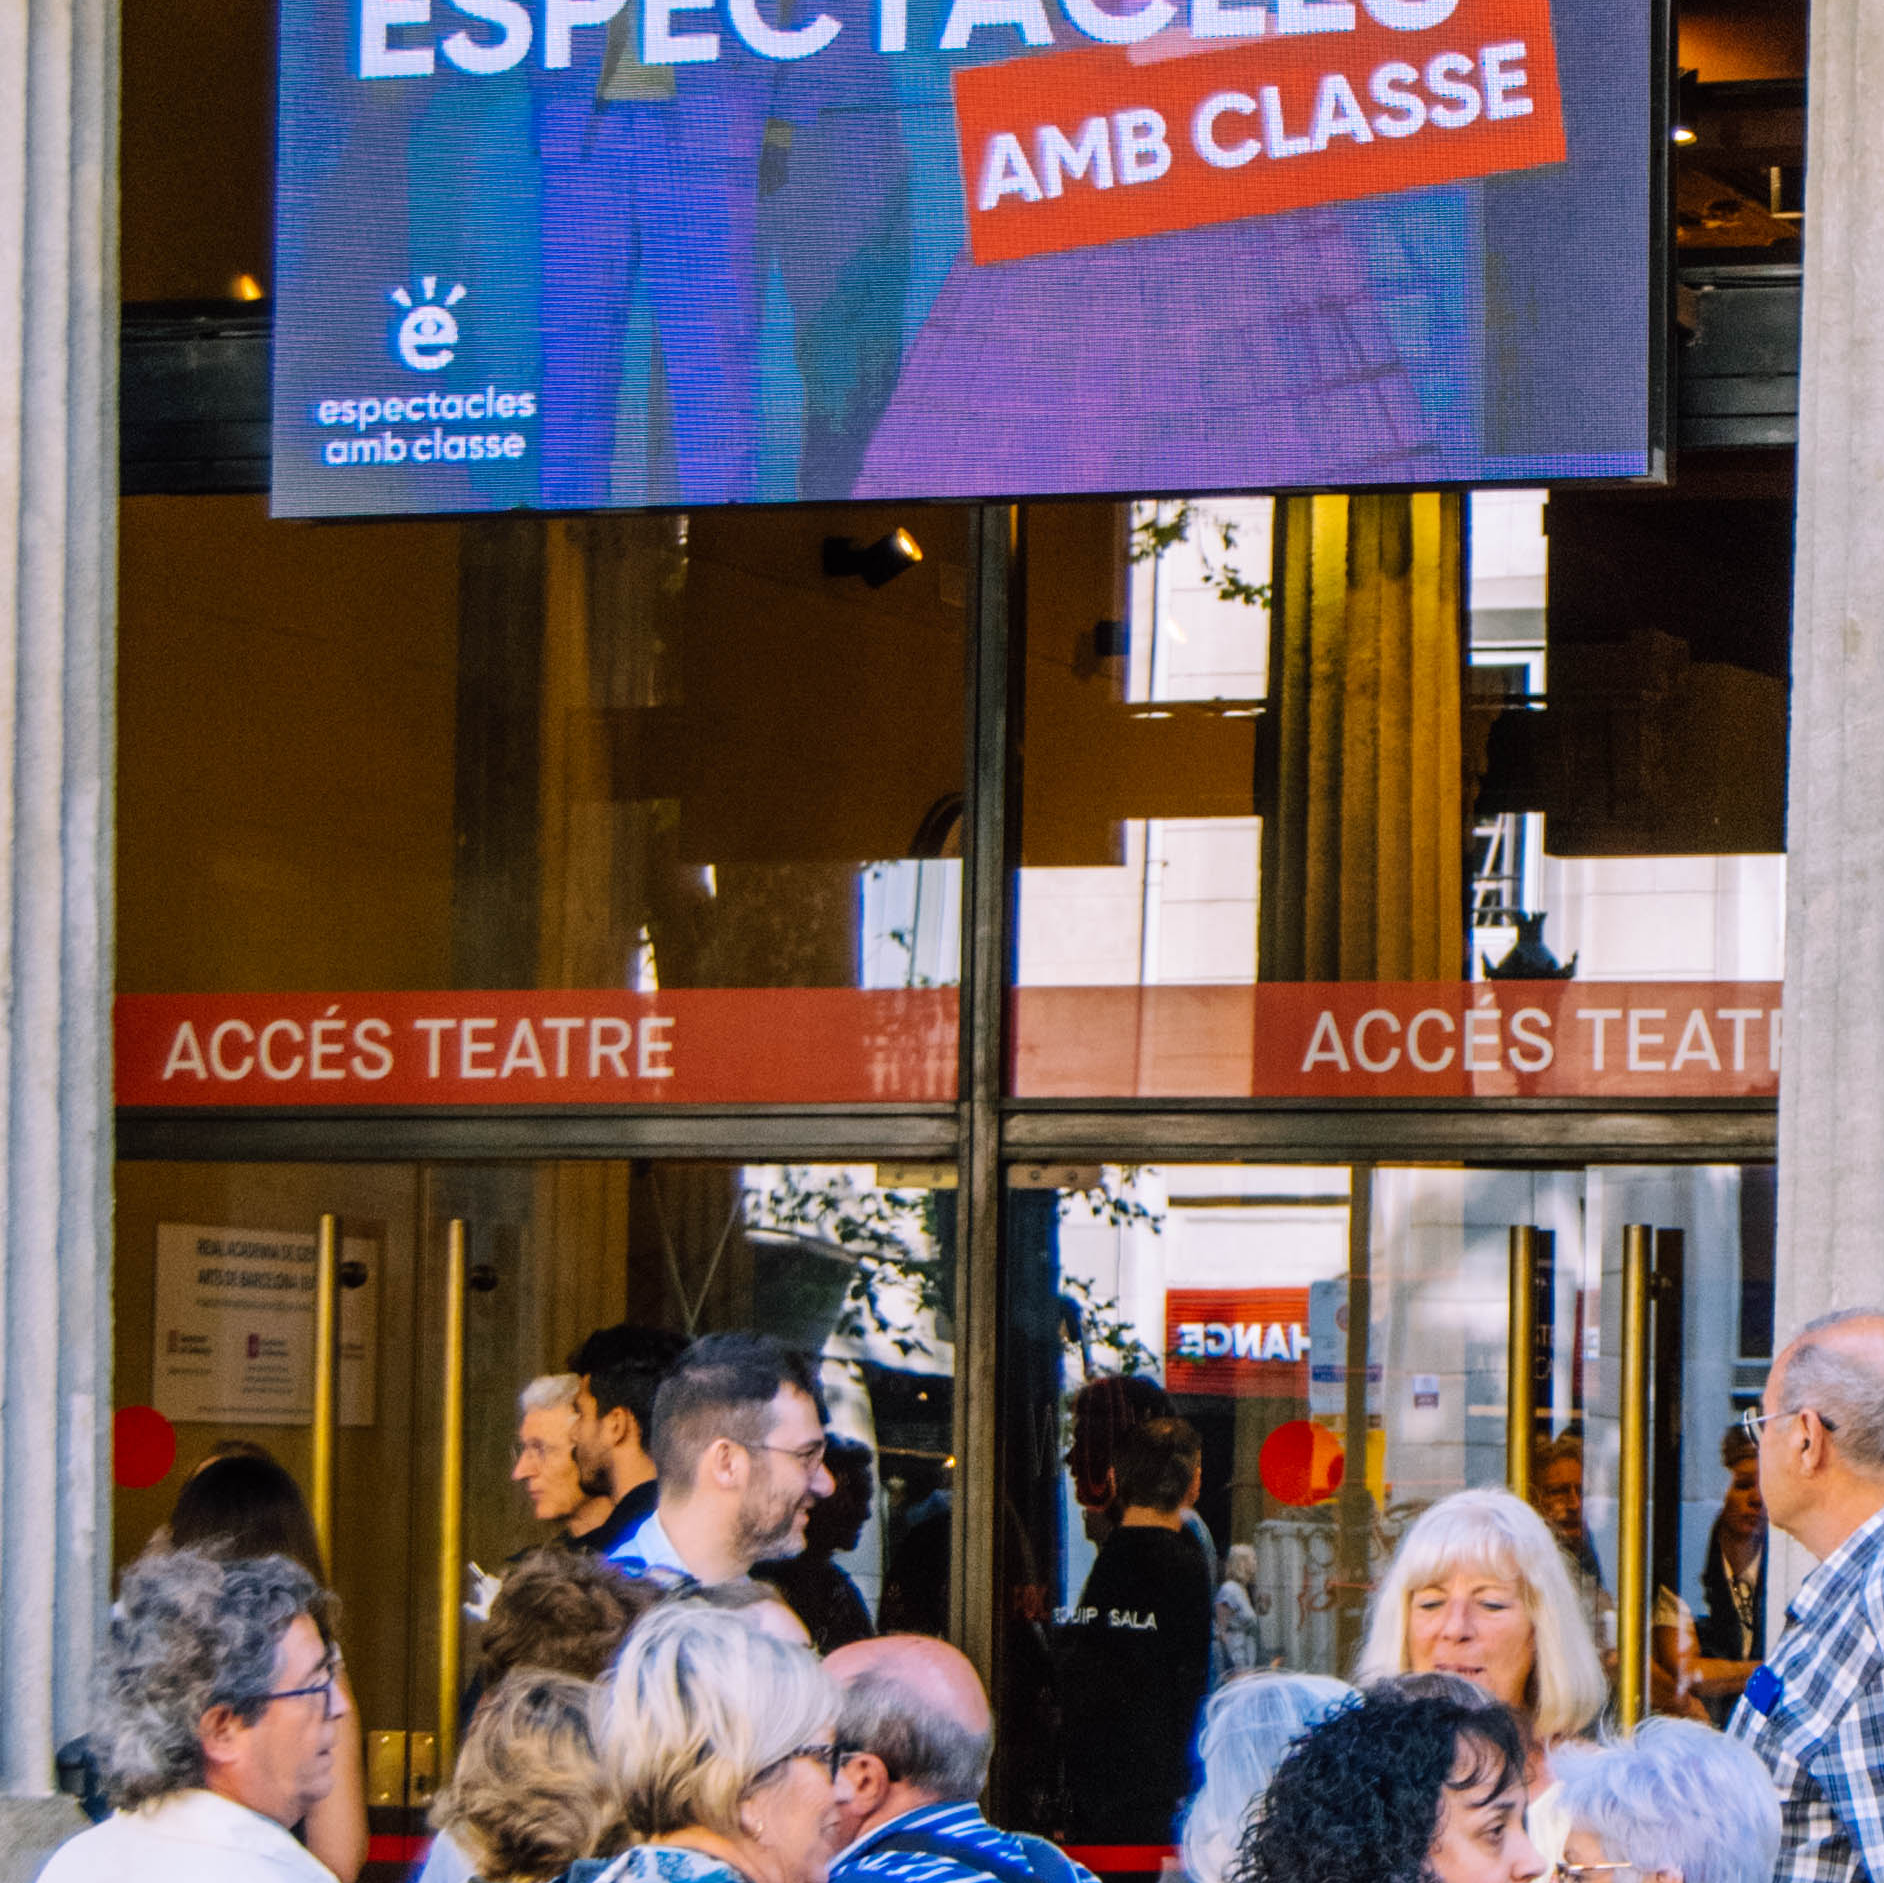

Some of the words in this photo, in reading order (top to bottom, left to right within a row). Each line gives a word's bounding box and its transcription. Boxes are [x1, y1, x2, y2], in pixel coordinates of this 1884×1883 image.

[974, 106, 1174, 213] AMB
[1190, 39, 1537, 172] CLASSE
[318, 384, 538, 433] espectacles
[324, 429, 408, 464] amb
[411, 426, 527, 461] classe
[161, 1005, 396, 1082] ACCÉS
[414, 1014, 678, 1080] TEATRE
[1301, 993, 1556, 1073] ACCÉS
[1108, 1608, 1158, 1630] SALA
